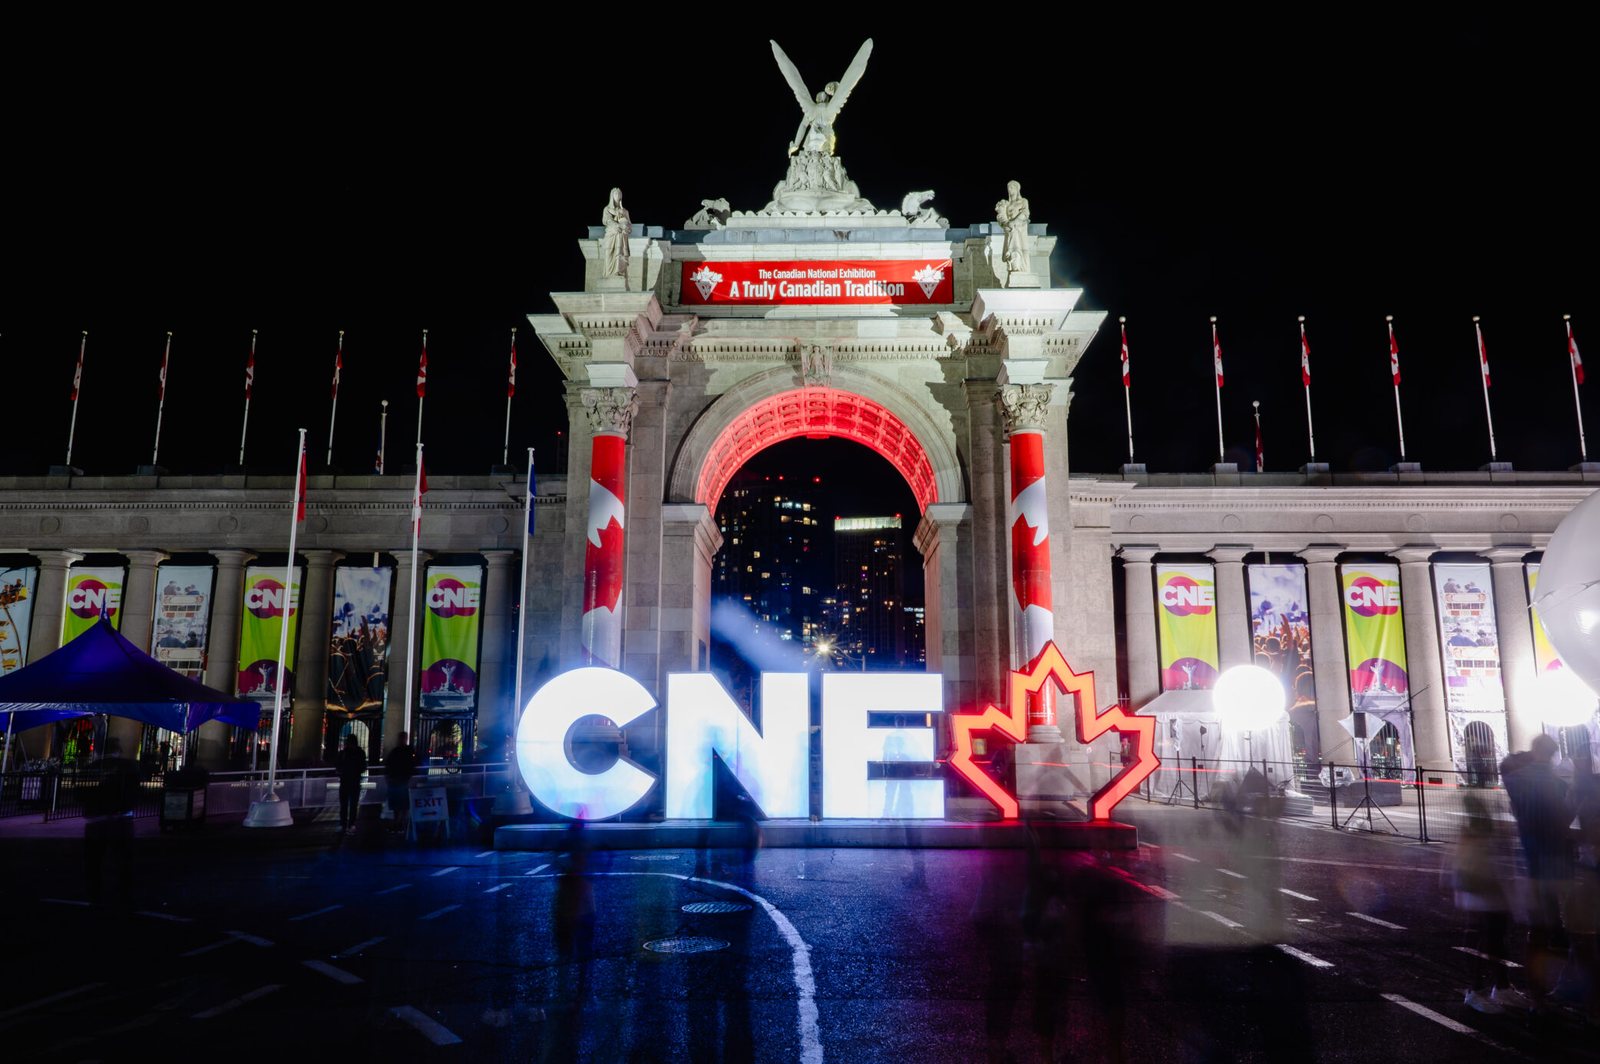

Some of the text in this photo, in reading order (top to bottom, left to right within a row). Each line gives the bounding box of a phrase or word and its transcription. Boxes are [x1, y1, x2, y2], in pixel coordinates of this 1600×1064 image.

[758, 268, 876, 279] The Canadian National Exhibition
[729, 280, 905, 300] A Truly Canadian Tradition
[68, 588, 121, 609] CNE
[245, 588, 299, 609] CNE
[426, 587, 480, 608] CNE
[1159, 585, 1215, 607] CNE
[1344, 585, 1401, 607] CNE
[515, 666, 945, 821] CNE
[414, 797, 443, 808] EXIT
